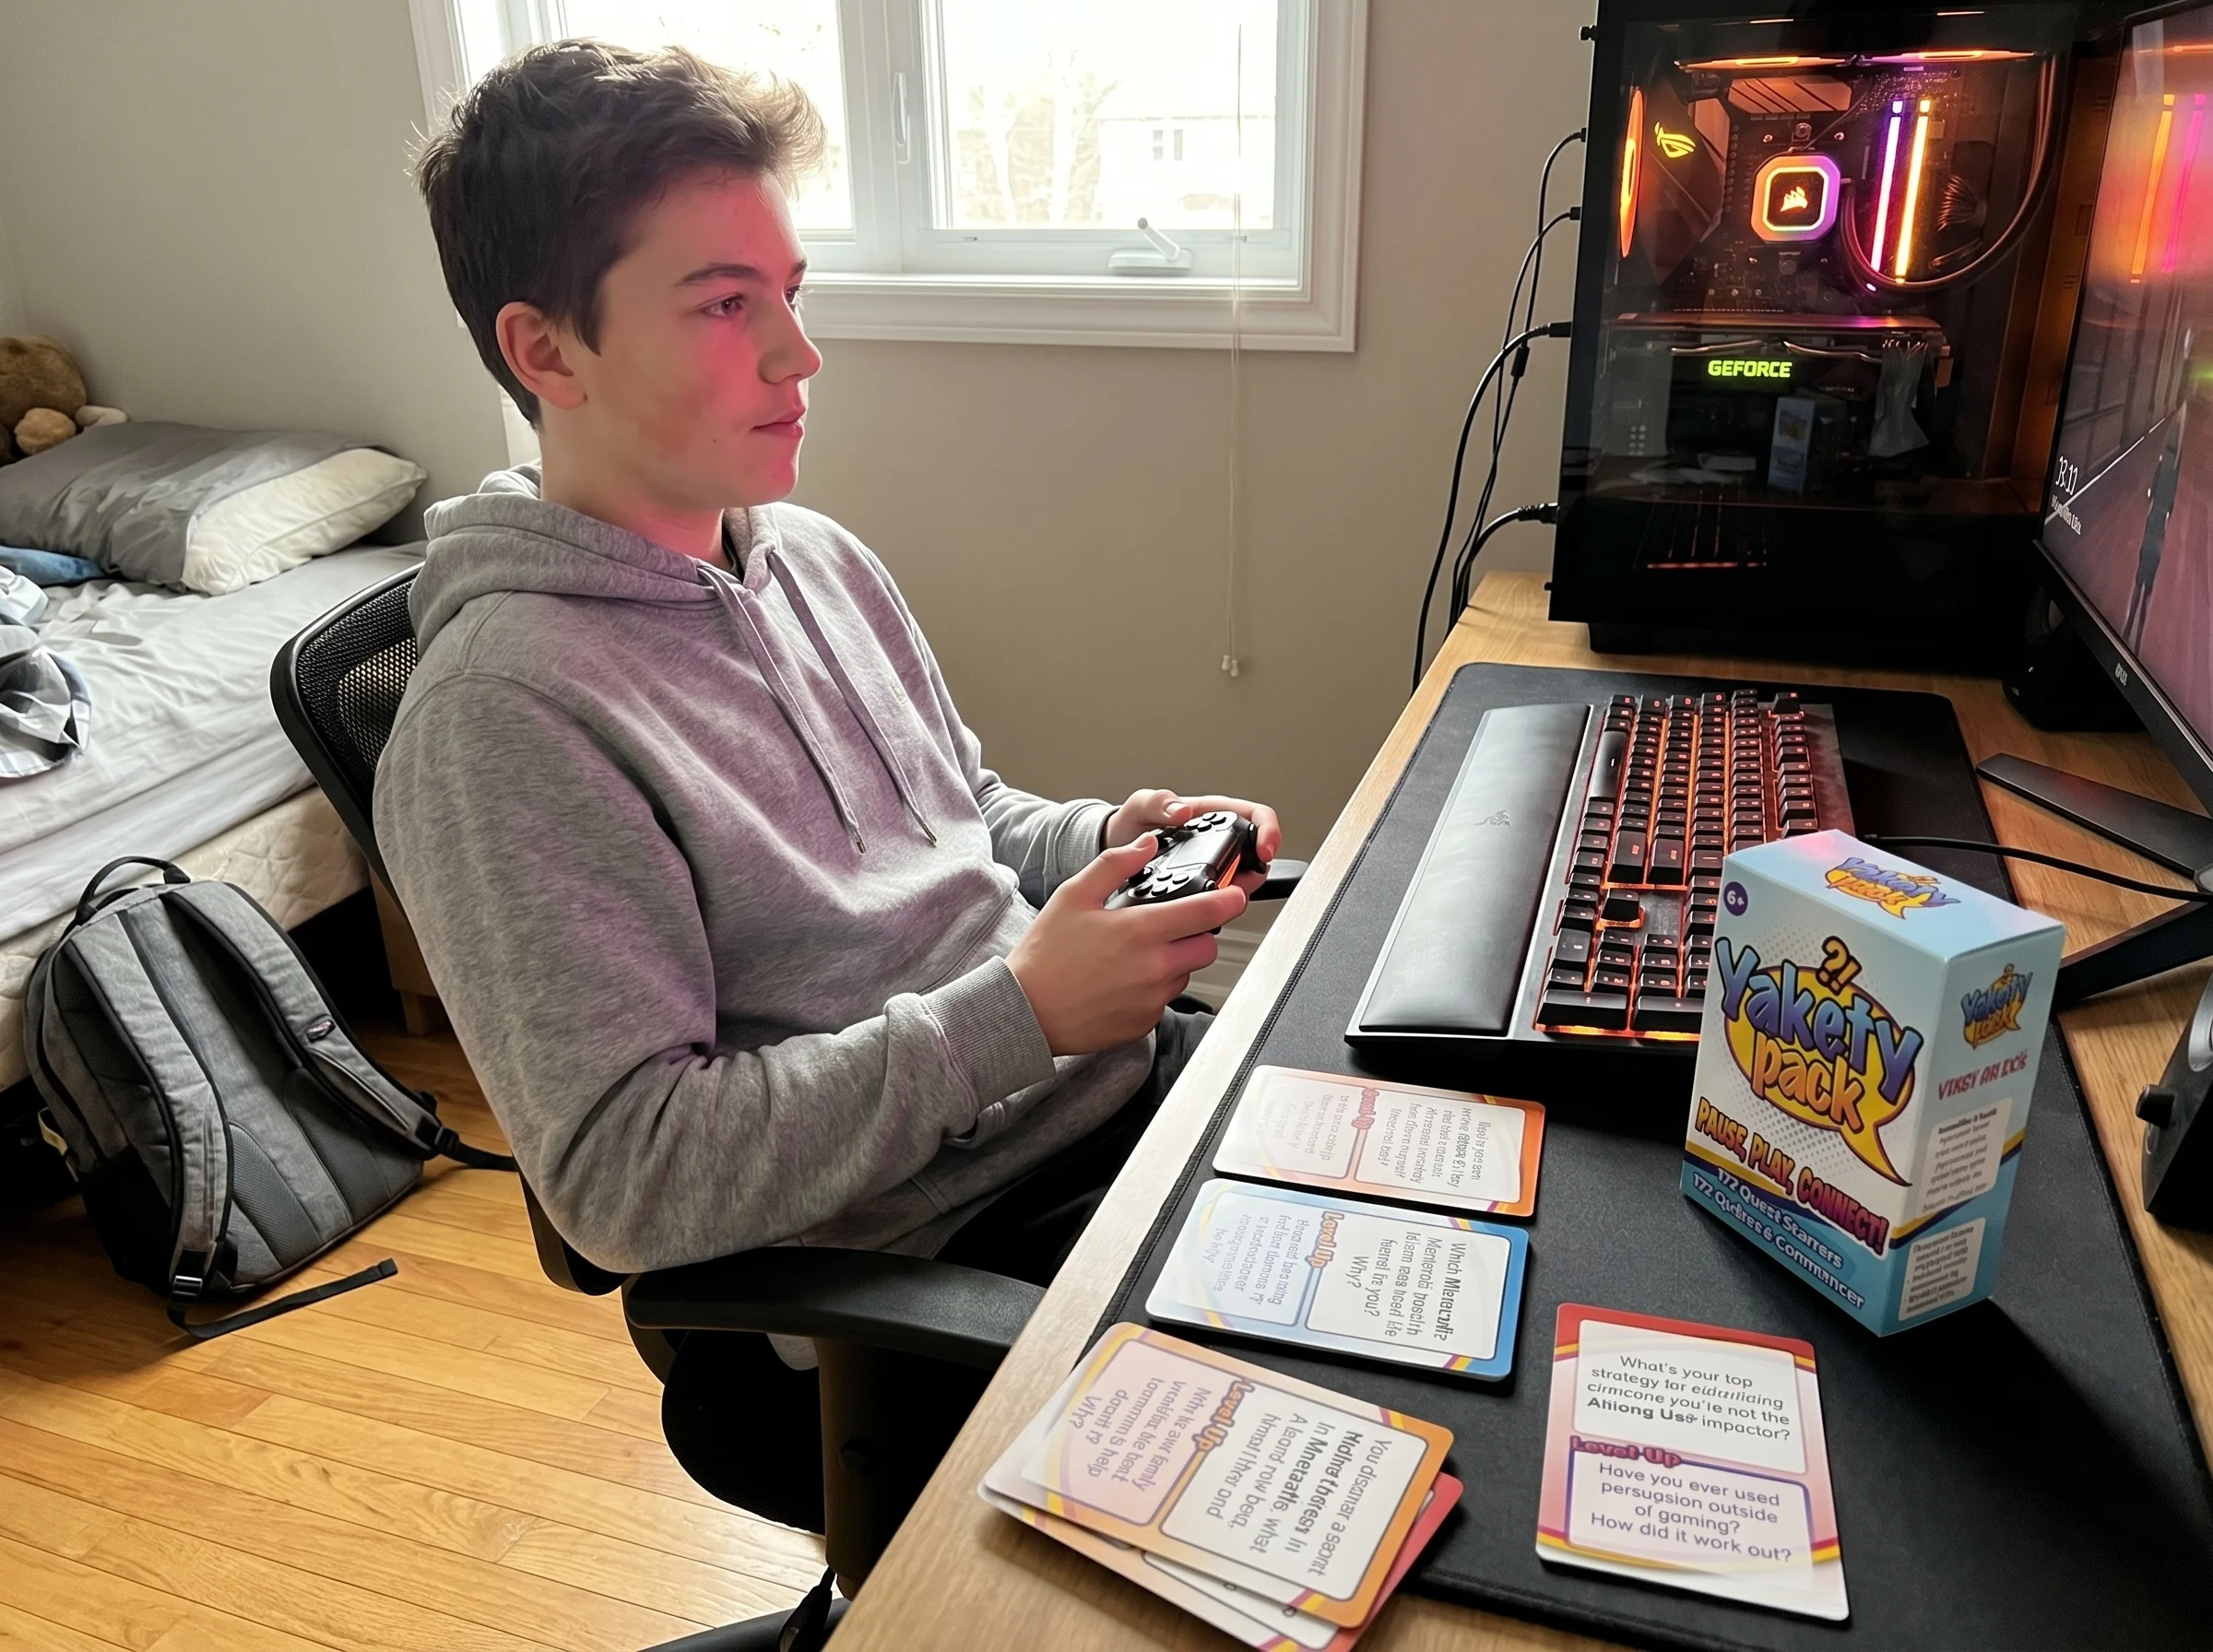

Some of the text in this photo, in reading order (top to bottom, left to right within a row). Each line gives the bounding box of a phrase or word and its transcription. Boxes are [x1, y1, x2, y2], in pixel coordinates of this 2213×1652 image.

[1708, 360, 1793, 378] GEFORCE
[1715, 937, 1924, 1105] Yakety
[1751, 1031, 1865, 1134] pack
[1695, 1096, 1748, 1163] PAUSE,
[1747, 1132, 1795, 1196] PLAY,
[1344, 1256, 1370, 1289] Why?
[1446, 1243, 1467, 1275] Which
[1364, 1287, 1382, 1317] you?
[1592, 1368, 1660, 1389] strategy
[1620, 1356, 1753, 1388] What's your top
[1289, 1412, 1308, 1424] A
[1703, 1416, 1790, 1440] impactor?
[1728, 1408, 1757, 1420] not
[1762, 1411, 1790, 1425] the
[1193, 1422, 1228, 1454] Up
[1366, 1439, 1393, 1465] You
[1643, 1446, 1682, 1469] Up
[1600, 1462, 1780, 1506] Have you ever used
[1330, 1521, 1346, 1533] a
[1635, 1504, 1740, 1535] of gaming?
[1709, 1502, 1778, 1523] outside
[1592, 1513, 1792, 1563] How did it work out?
